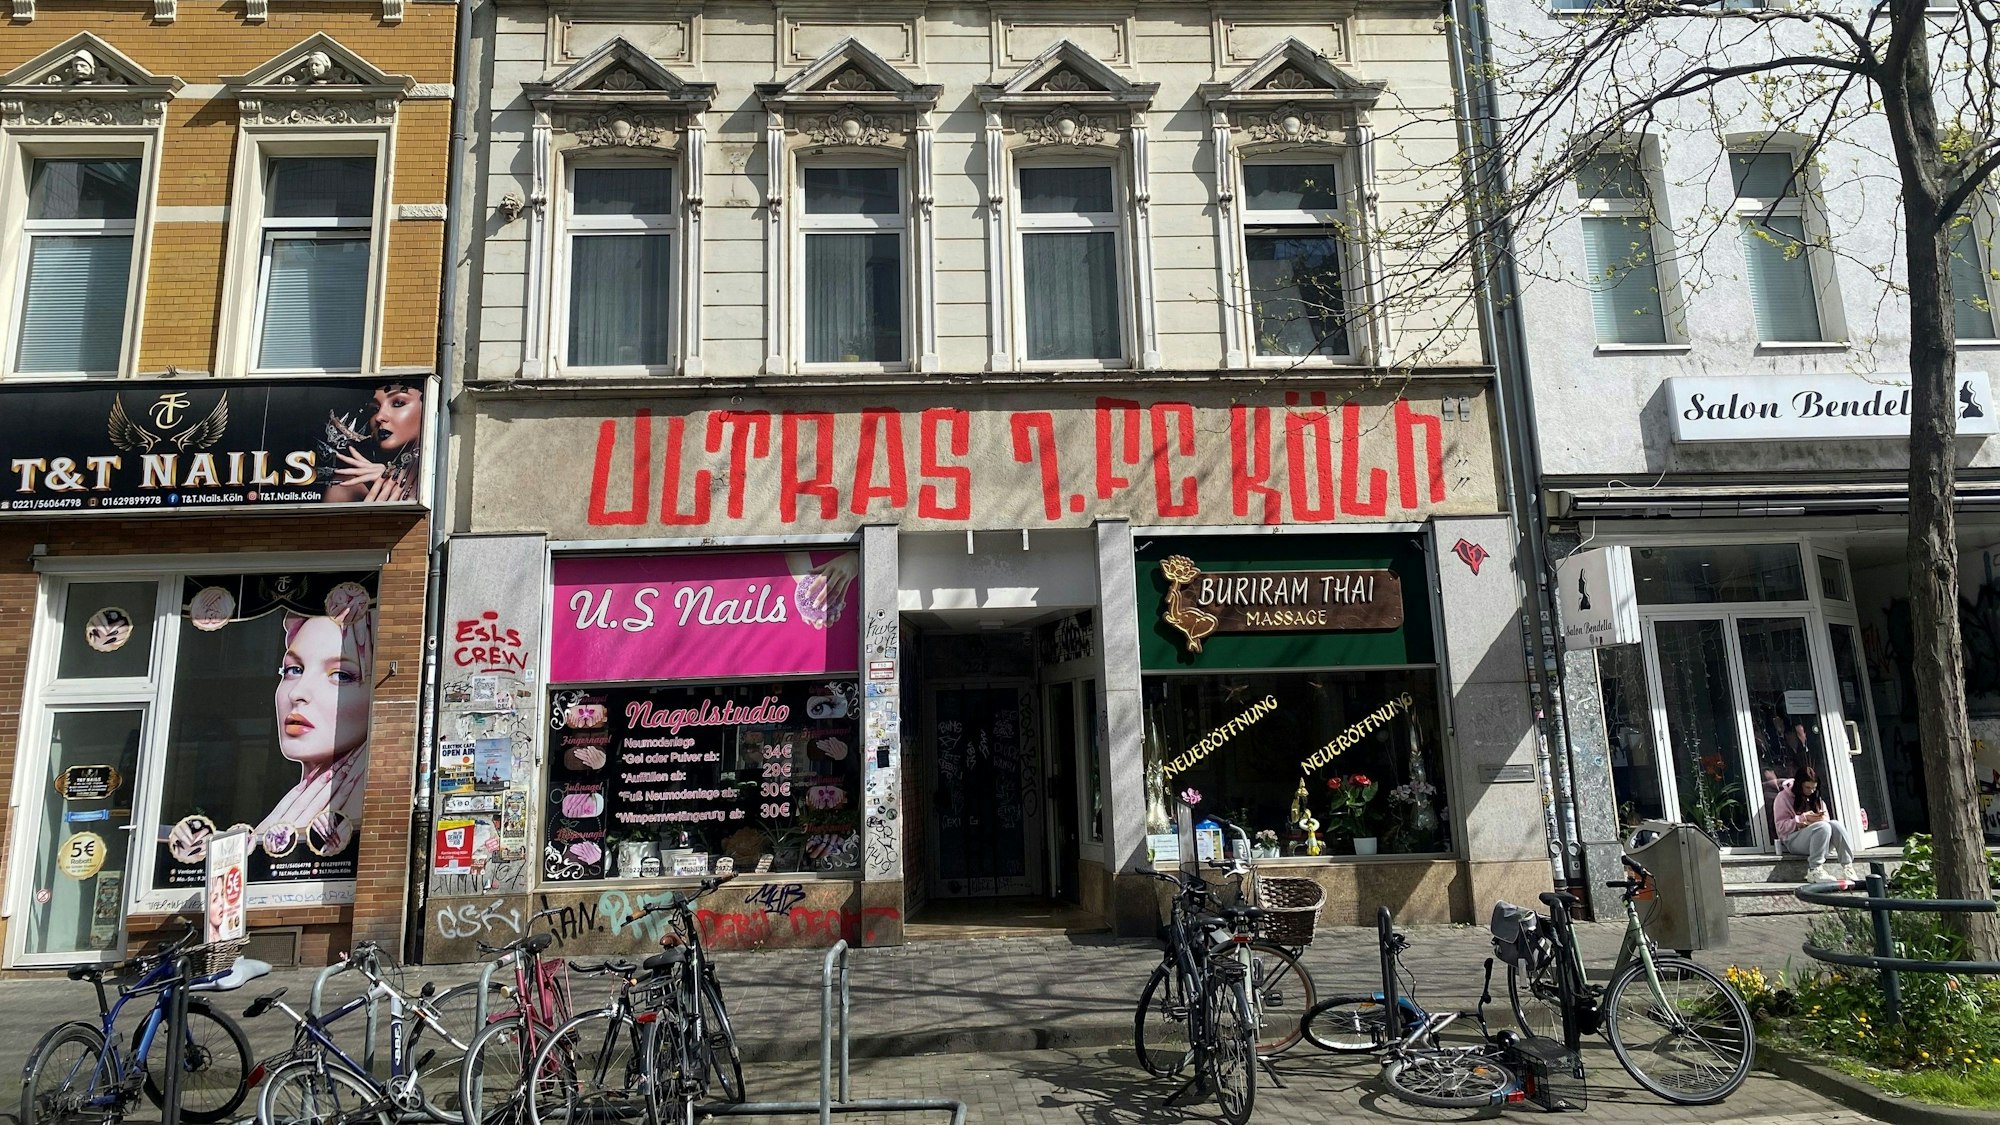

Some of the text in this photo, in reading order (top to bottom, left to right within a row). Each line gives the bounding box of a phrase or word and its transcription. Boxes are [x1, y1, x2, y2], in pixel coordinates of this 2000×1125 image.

[1683, 389, 1912, 421] Salon Bendel
[12, 449, 319, 494] T&T NAILS
[587, 408, 971, 526] ULTRAS
[12, 491, 321, 509] 0221/56064798 01629899978 T&T.Nails.Köln T&T.Nails.Köln
[1198, 575, 1375, 606] BURIRAM THAI
[569, 584, 788, 633] U.S Nails
[1246, 609, 1328, 627] MASSAGE
[1566, 619, 1613, 637] Salon Bendella
[454, 647, 529, 670] CREW
[625, 696, 790, 735] Nagelstudio
[560, 734, 612, 746] Fingernagel
[1163, 694, 1279, 780] NEUERÖFFNUNG
[1300, 691, 1413, 776] NEUERÖFFNUNG
[442, 749, 460, 757] OPEN
[645, 753, 669, 764] oder
[670, 752, 703, 763] Pulver
[704, 750, 720, 762] ab:
[763, 744, 793, 760] 34€
[670, 770, 687, 781] ab:
[762, 763, 792, 778] 29€
[563, 781, 603, 793] Fußnagel
[645, 788, 720, 801] Neumodenlage
[721, 787, 738, 798] ab:
[760, 781, 791, 797] 30€
[729, 808, 745, 819] ab:
[760, 802, 790, 819] 30€
[70, 840, 95, 858] 5€
[226, 872, 241, 894] 5€
